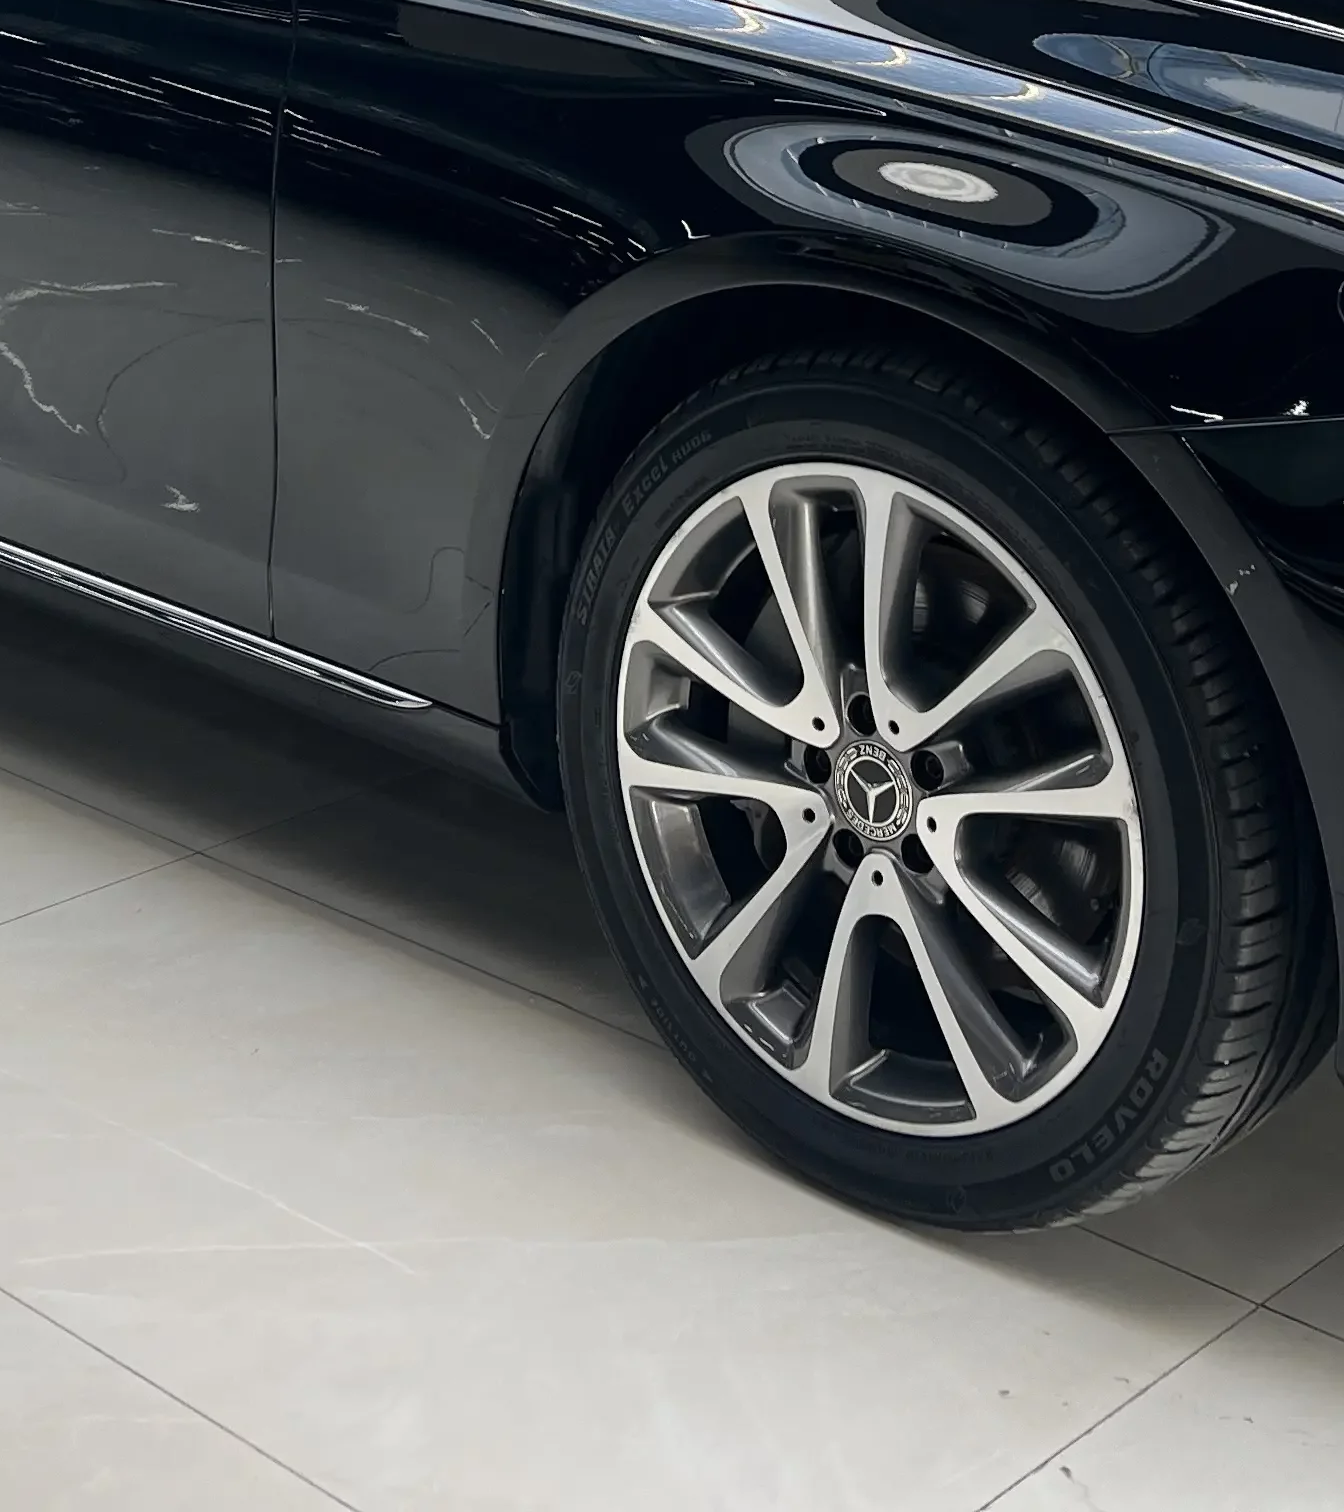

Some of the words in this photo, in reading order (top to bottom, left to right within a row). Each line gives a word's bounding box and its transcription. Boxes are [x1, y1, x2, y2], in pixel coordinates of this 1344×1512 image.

[859, 744, 887, 762] BENZ
[846, 808, 898, 838] MERCEDES
[1049, 1047, 1169, 1183] ROVELO
